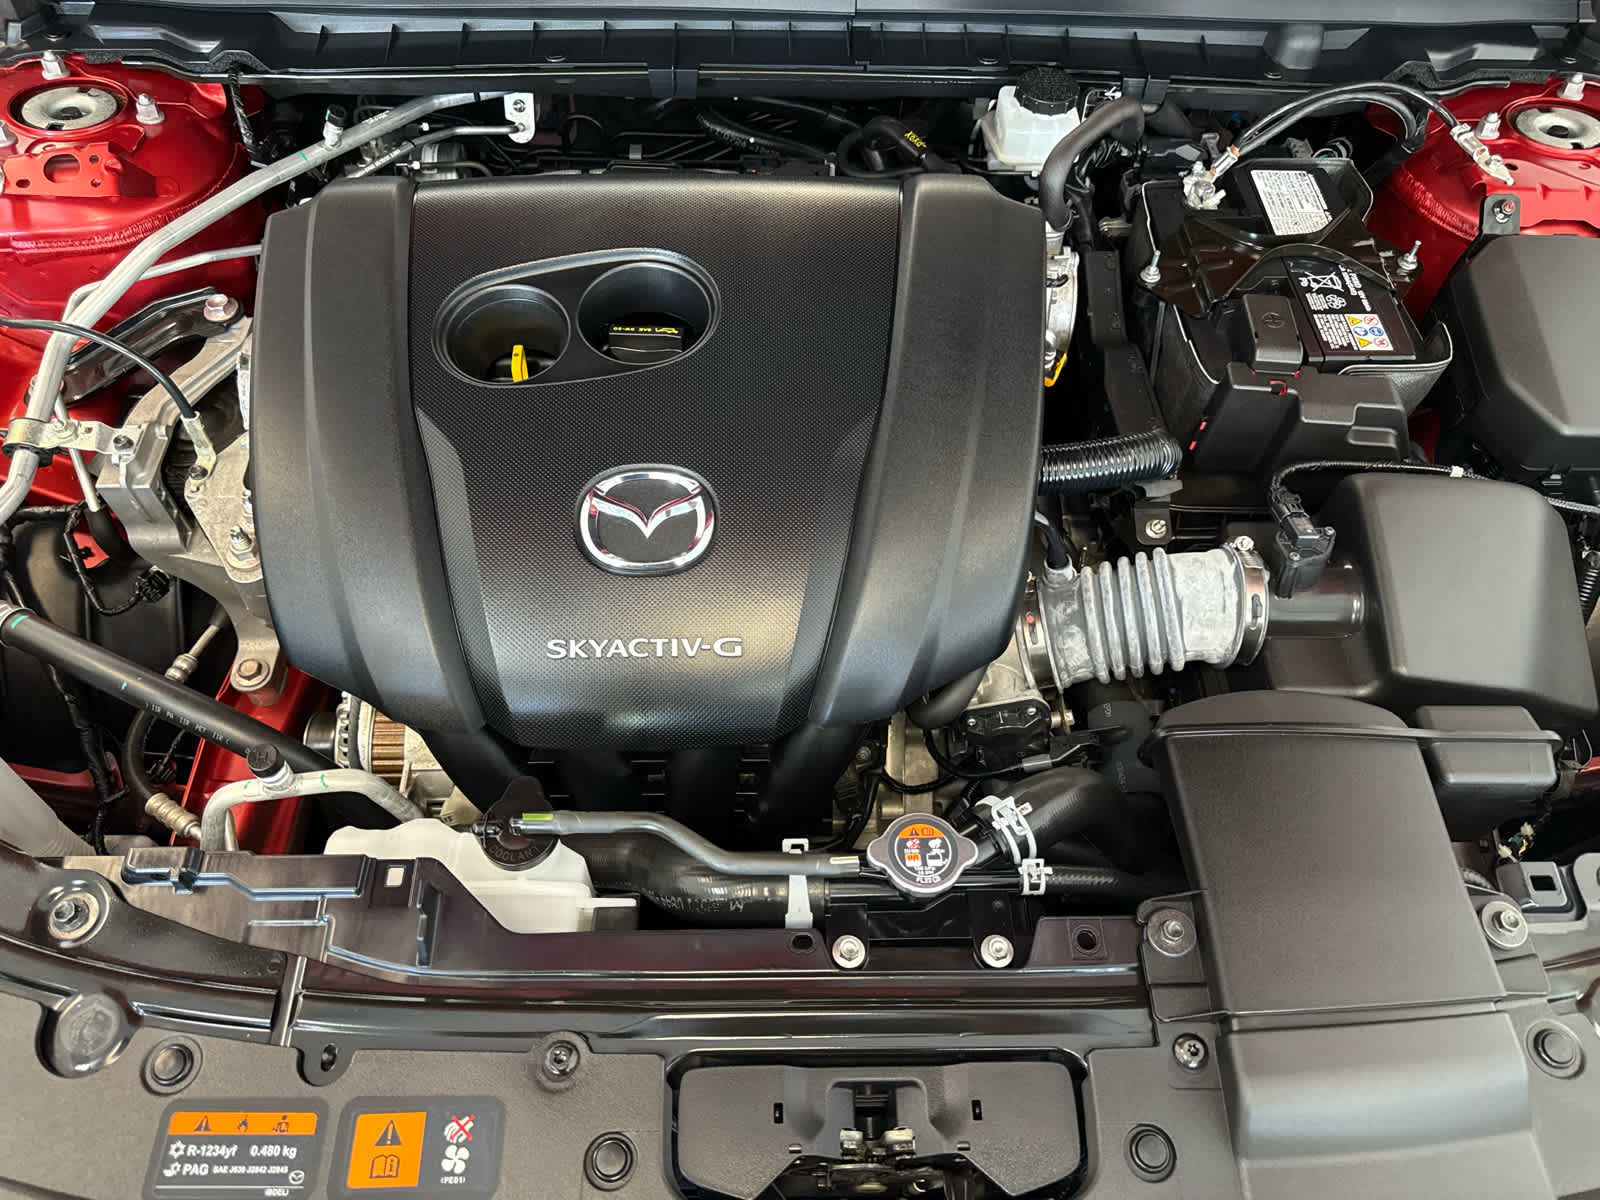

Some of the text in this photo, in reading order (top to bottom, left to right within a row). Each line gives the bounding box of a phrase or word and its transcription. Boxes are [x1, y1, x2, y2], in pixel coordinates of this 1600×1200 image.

[546, 637, 744, 659] SKYACTIV-G
[186, 1145, 298, 1159] R-1234yf 0.480 kg
[182, 1163, 209, 1176] PAG
